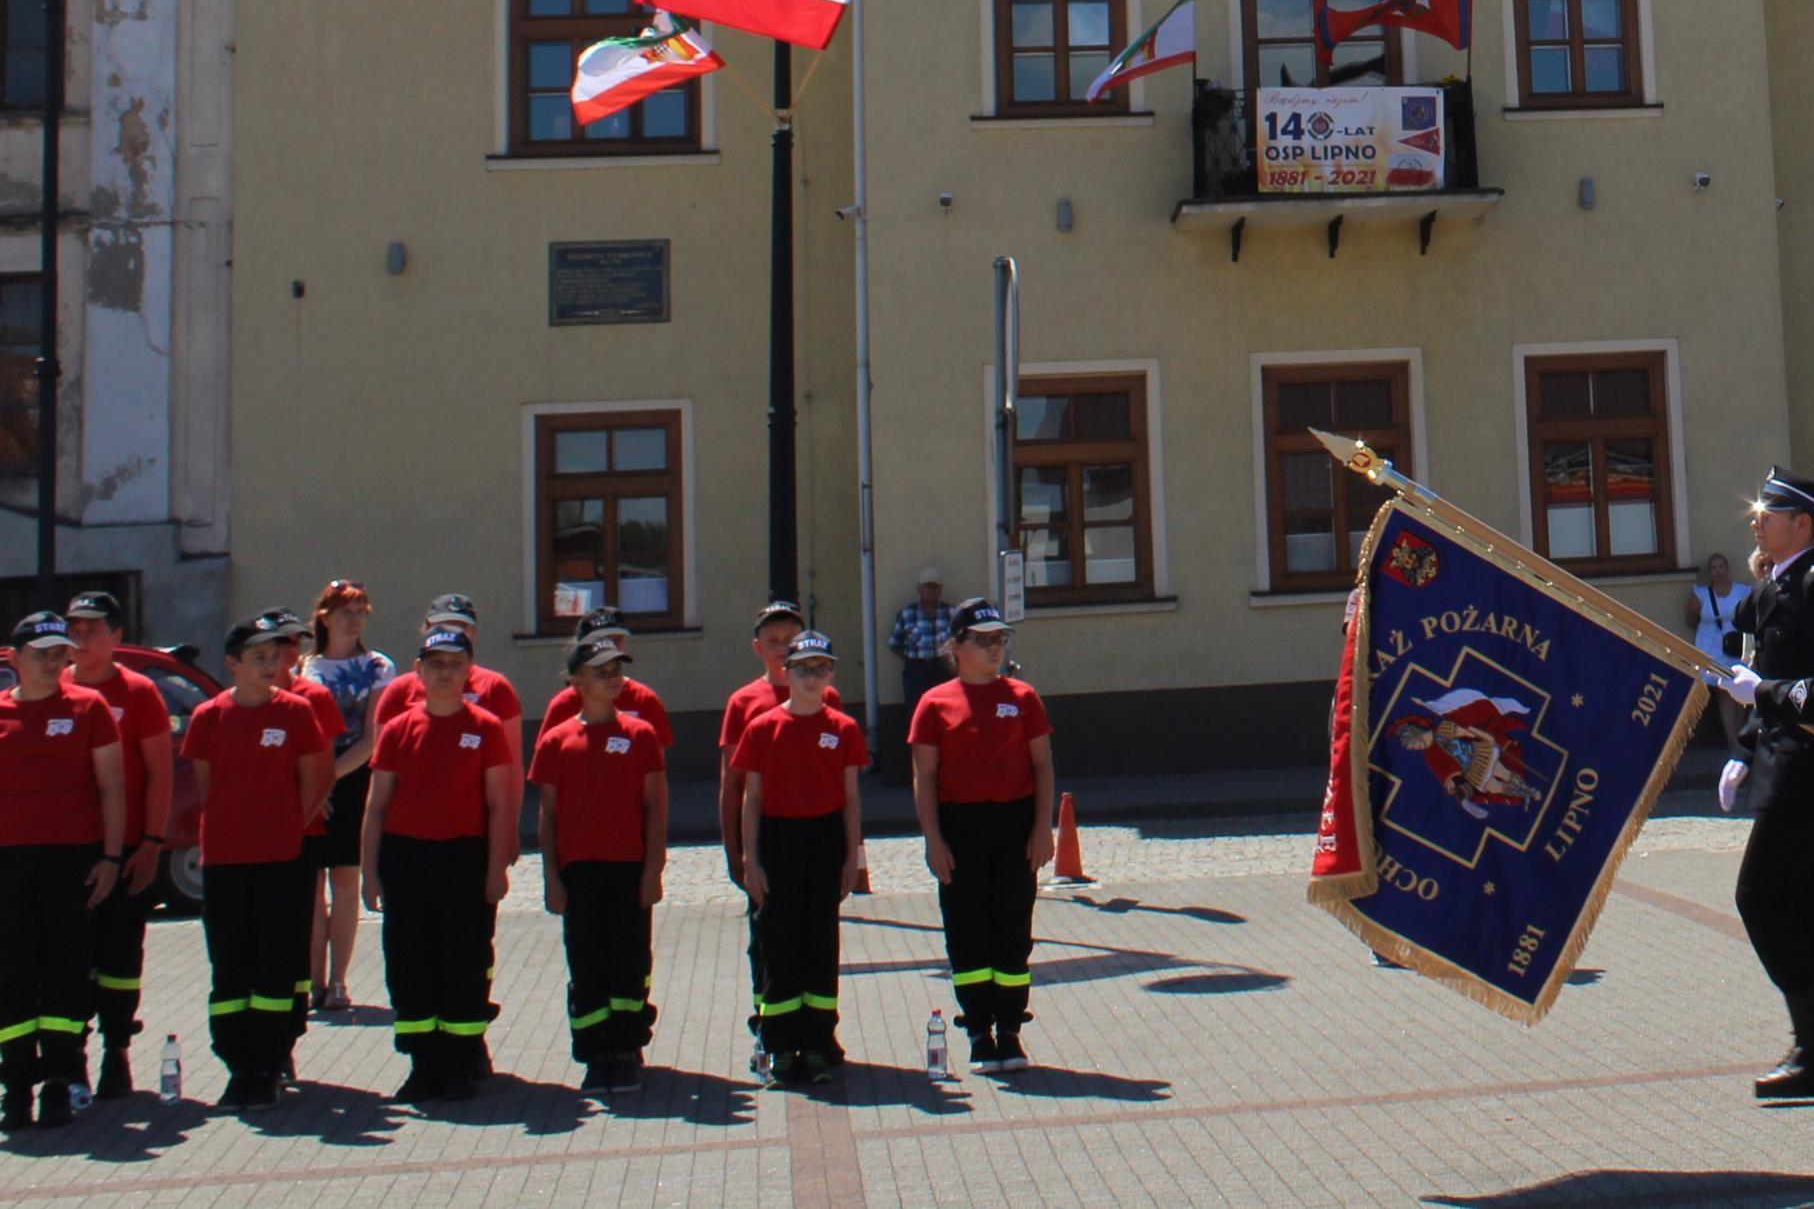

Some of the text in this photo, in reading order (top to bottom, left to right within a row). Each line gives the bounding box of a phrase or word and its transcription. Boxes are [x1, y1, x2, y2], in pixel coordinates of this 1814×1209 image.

[1265, 144, 1376, 161] OSP LIPNO
[1269, 169, 1306, 186] 1881
[1328, 169, 1376, 186] 2021
[1370, 605, 1551, 679] AŻ POŻARNA
[1632, 672, 1669, 727] 2021
[1543, 766, 1600, 863] LIPNO
[1508, 923, 1547, 978] 1881
